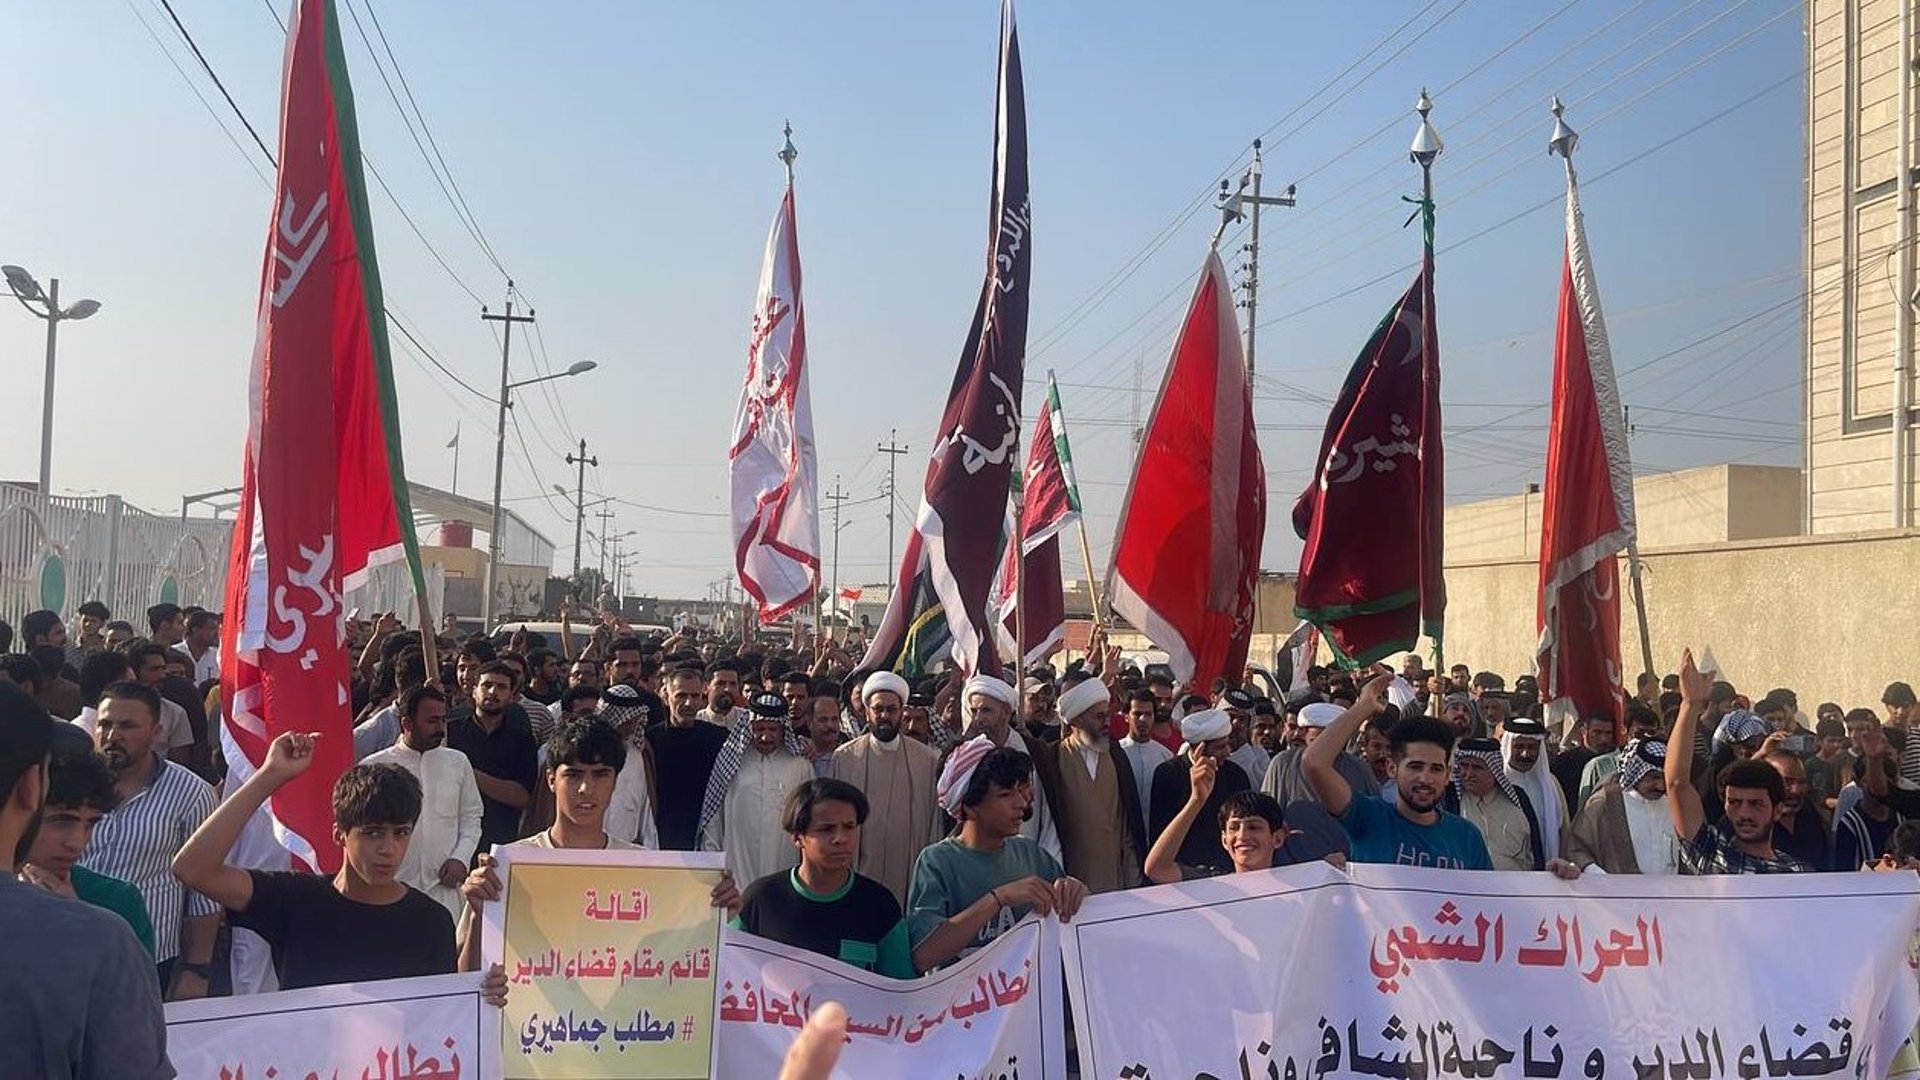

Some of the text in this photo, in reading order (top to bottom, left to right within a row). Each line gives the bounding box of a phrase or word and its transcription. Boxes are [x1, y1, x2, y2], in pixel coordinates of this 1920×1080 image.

[585, 889, 648, 921] اقالة
[510, 946, 711, 987] قائم مقام قضاء الدير
[1369, 900, 1664, 995] الحراك الشعبي
[952, 959, 1032, 1029] نطالب
[521, 1009, 608, 1054] جماهيري
[613, 1008, 675, 1053] مطلب
[845, 1015, 905, 1044] السي
[904, 1007, 948, 1043] من
[362, 1036, 462, 1080] نطال
[1738, 1018, 1852, 1079] قضاء
